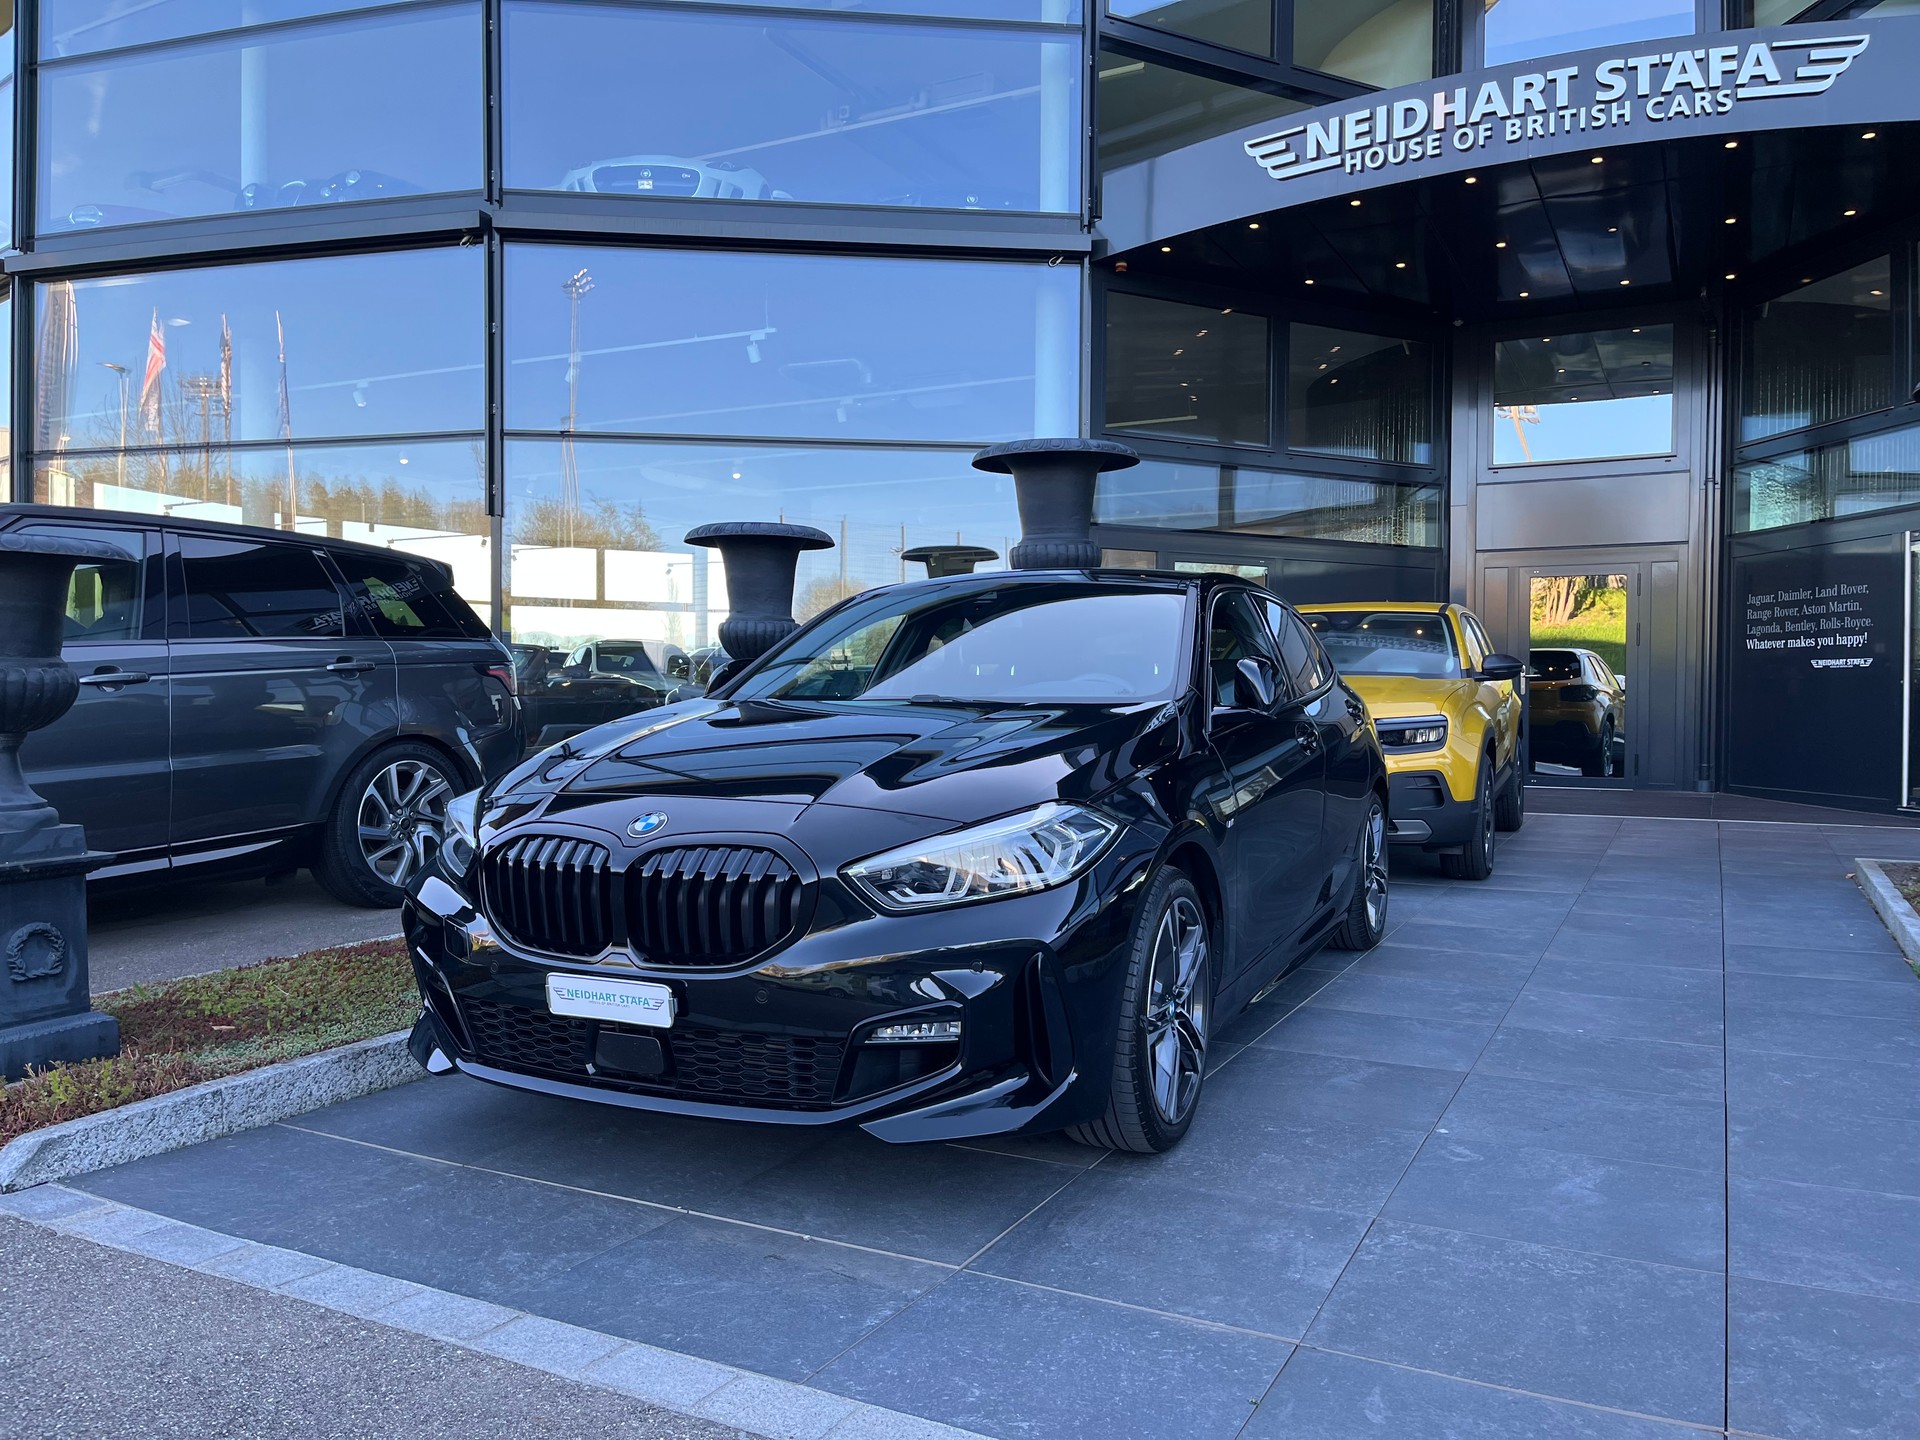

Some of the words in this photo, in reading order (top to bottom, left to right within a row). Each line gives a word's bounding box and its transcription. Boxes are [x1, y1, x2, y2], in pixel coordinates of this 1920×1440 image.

[1306, 66, 1578, 160] NEIDHART
[1595, 43, 1782, 102] STÄFA
[1345, 134, 1442, 174] HOUSE
[1453, 123, 1492, 151] OF
[1505, 100, 1631, 142] BRITISH
[1645, 88, 1734, 120] CARS
[1746, 593, 1776, 607] Jaguar,
[1778, 588, 1813, 601] Daimler,
[1815, 584, 1838, 598] Land
[1840, 583, 1869, 596] Rover,
[1746, 608, 1772, 621] Range
[1774, 606, 1800, 618] Rover,
[1801, 603, 1827, 616] Aston
[1828, 599, 1863, 613] Martin,
[1746, 621, 1783, 637] Lagonda,
[1785, 619, 1818, 634] Bentley,
[1820, 616, 1874, 631] Rolls-Royce.
[1746, 638, 1786, 650] Whatever
[1787, 635, 1816, 648] makes
[1817, 636, 1834, 649] you
[1836, 631, 1868, 648] happy!
[1818, 658, 1847, 666] NEIDHART
[566, 988, 617, 1002] NEIDHART
[619, 994, 651, 1007] STÄFA
